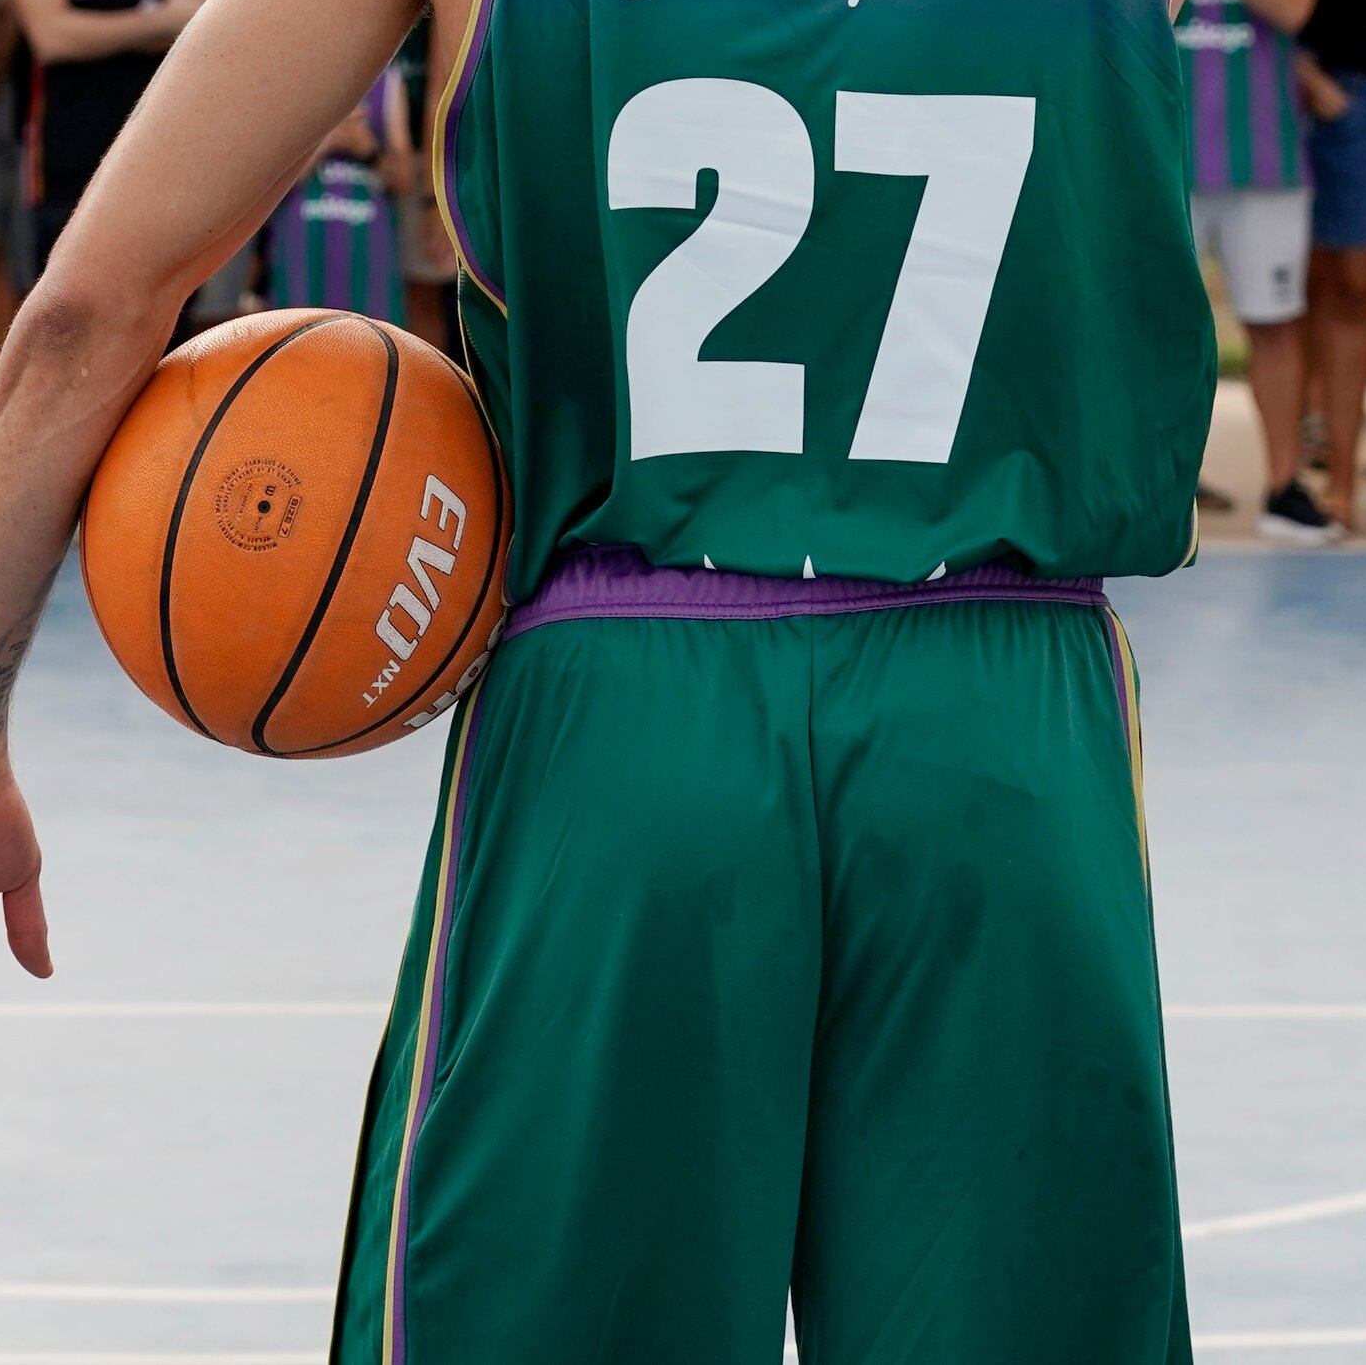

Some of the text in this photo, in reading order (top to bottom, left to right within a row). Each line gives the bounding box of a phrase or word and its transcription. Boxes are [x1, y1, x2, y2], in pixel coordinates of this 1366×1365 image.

[607, 77, 1037, 464] 27
[285, 498, 298, 524] SIZE
[375, 473, 467, 661] EVO
[362, 659, 401, 708] NXT
